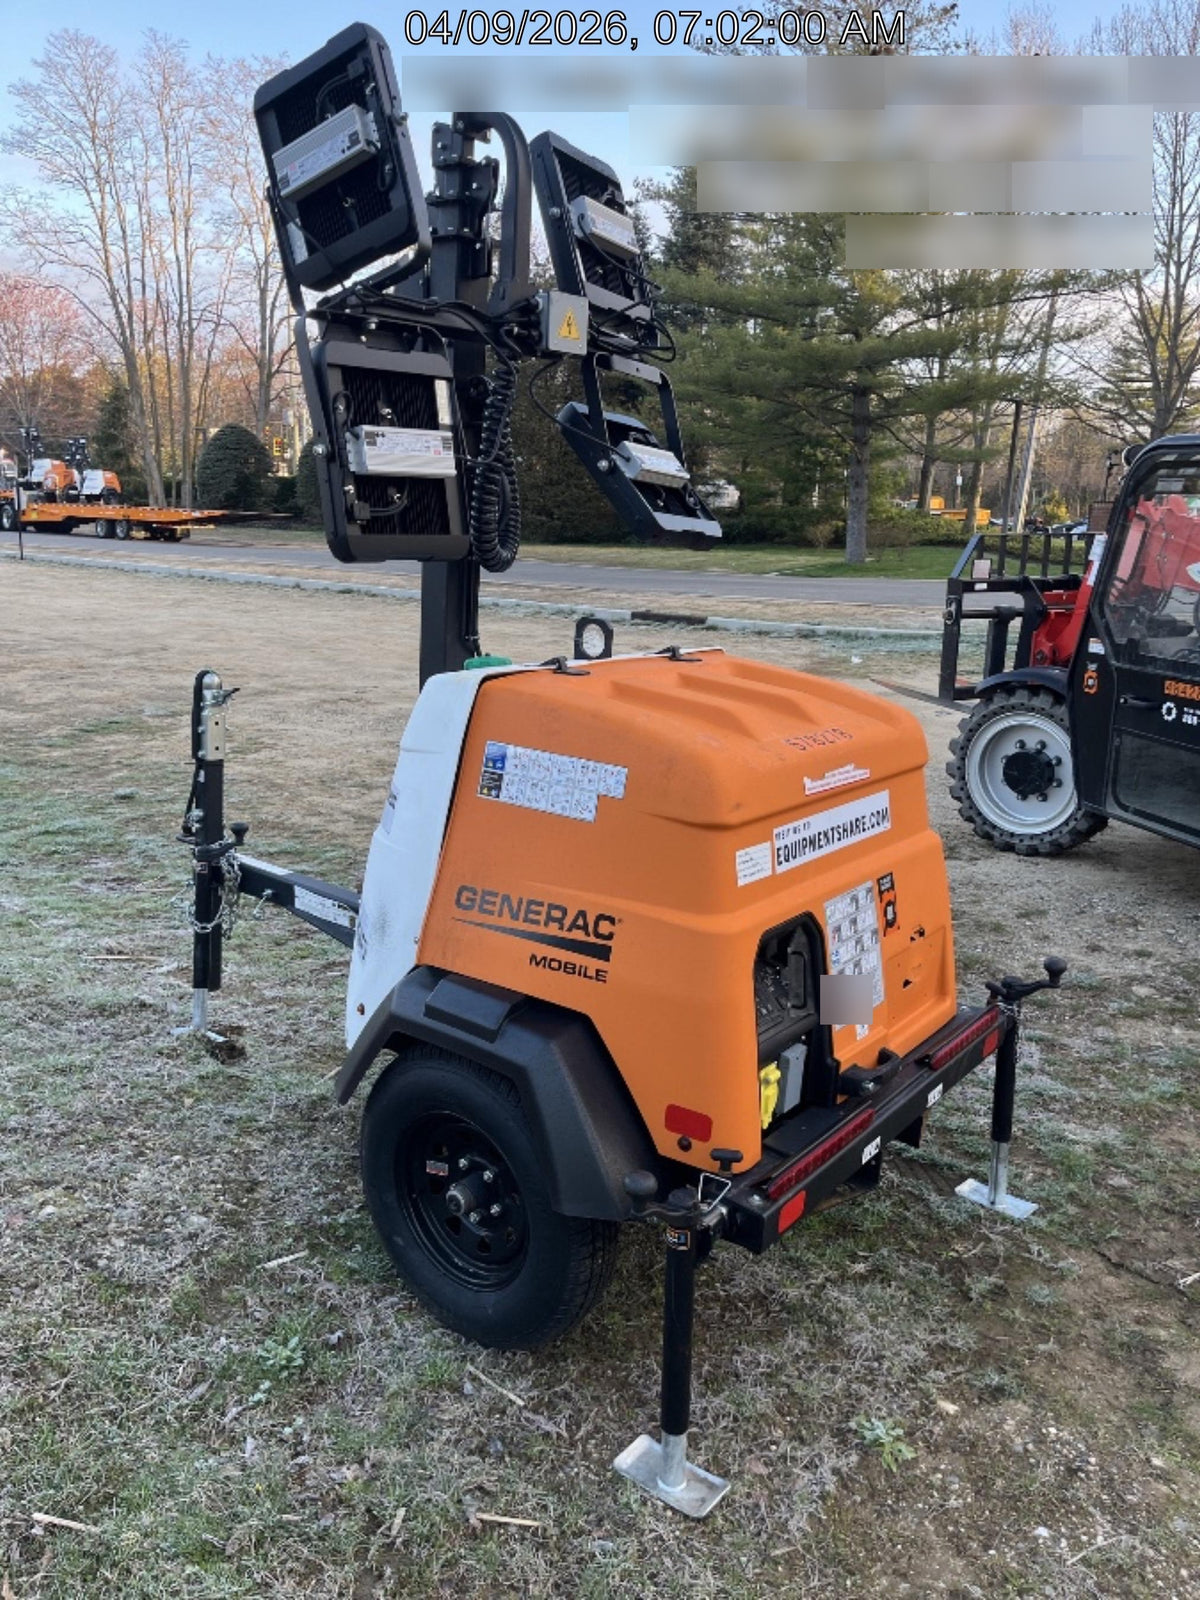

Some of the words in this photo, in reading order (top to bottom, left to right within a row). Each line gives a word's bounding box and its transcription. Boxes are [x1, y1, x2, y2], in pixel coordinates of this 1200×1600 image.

[776, 807, 889, 867] EQUIPMENTSHARE.COM
[455, 885, 616, 941] GENERAC
[529, 954, 608, 983] MOBILE
